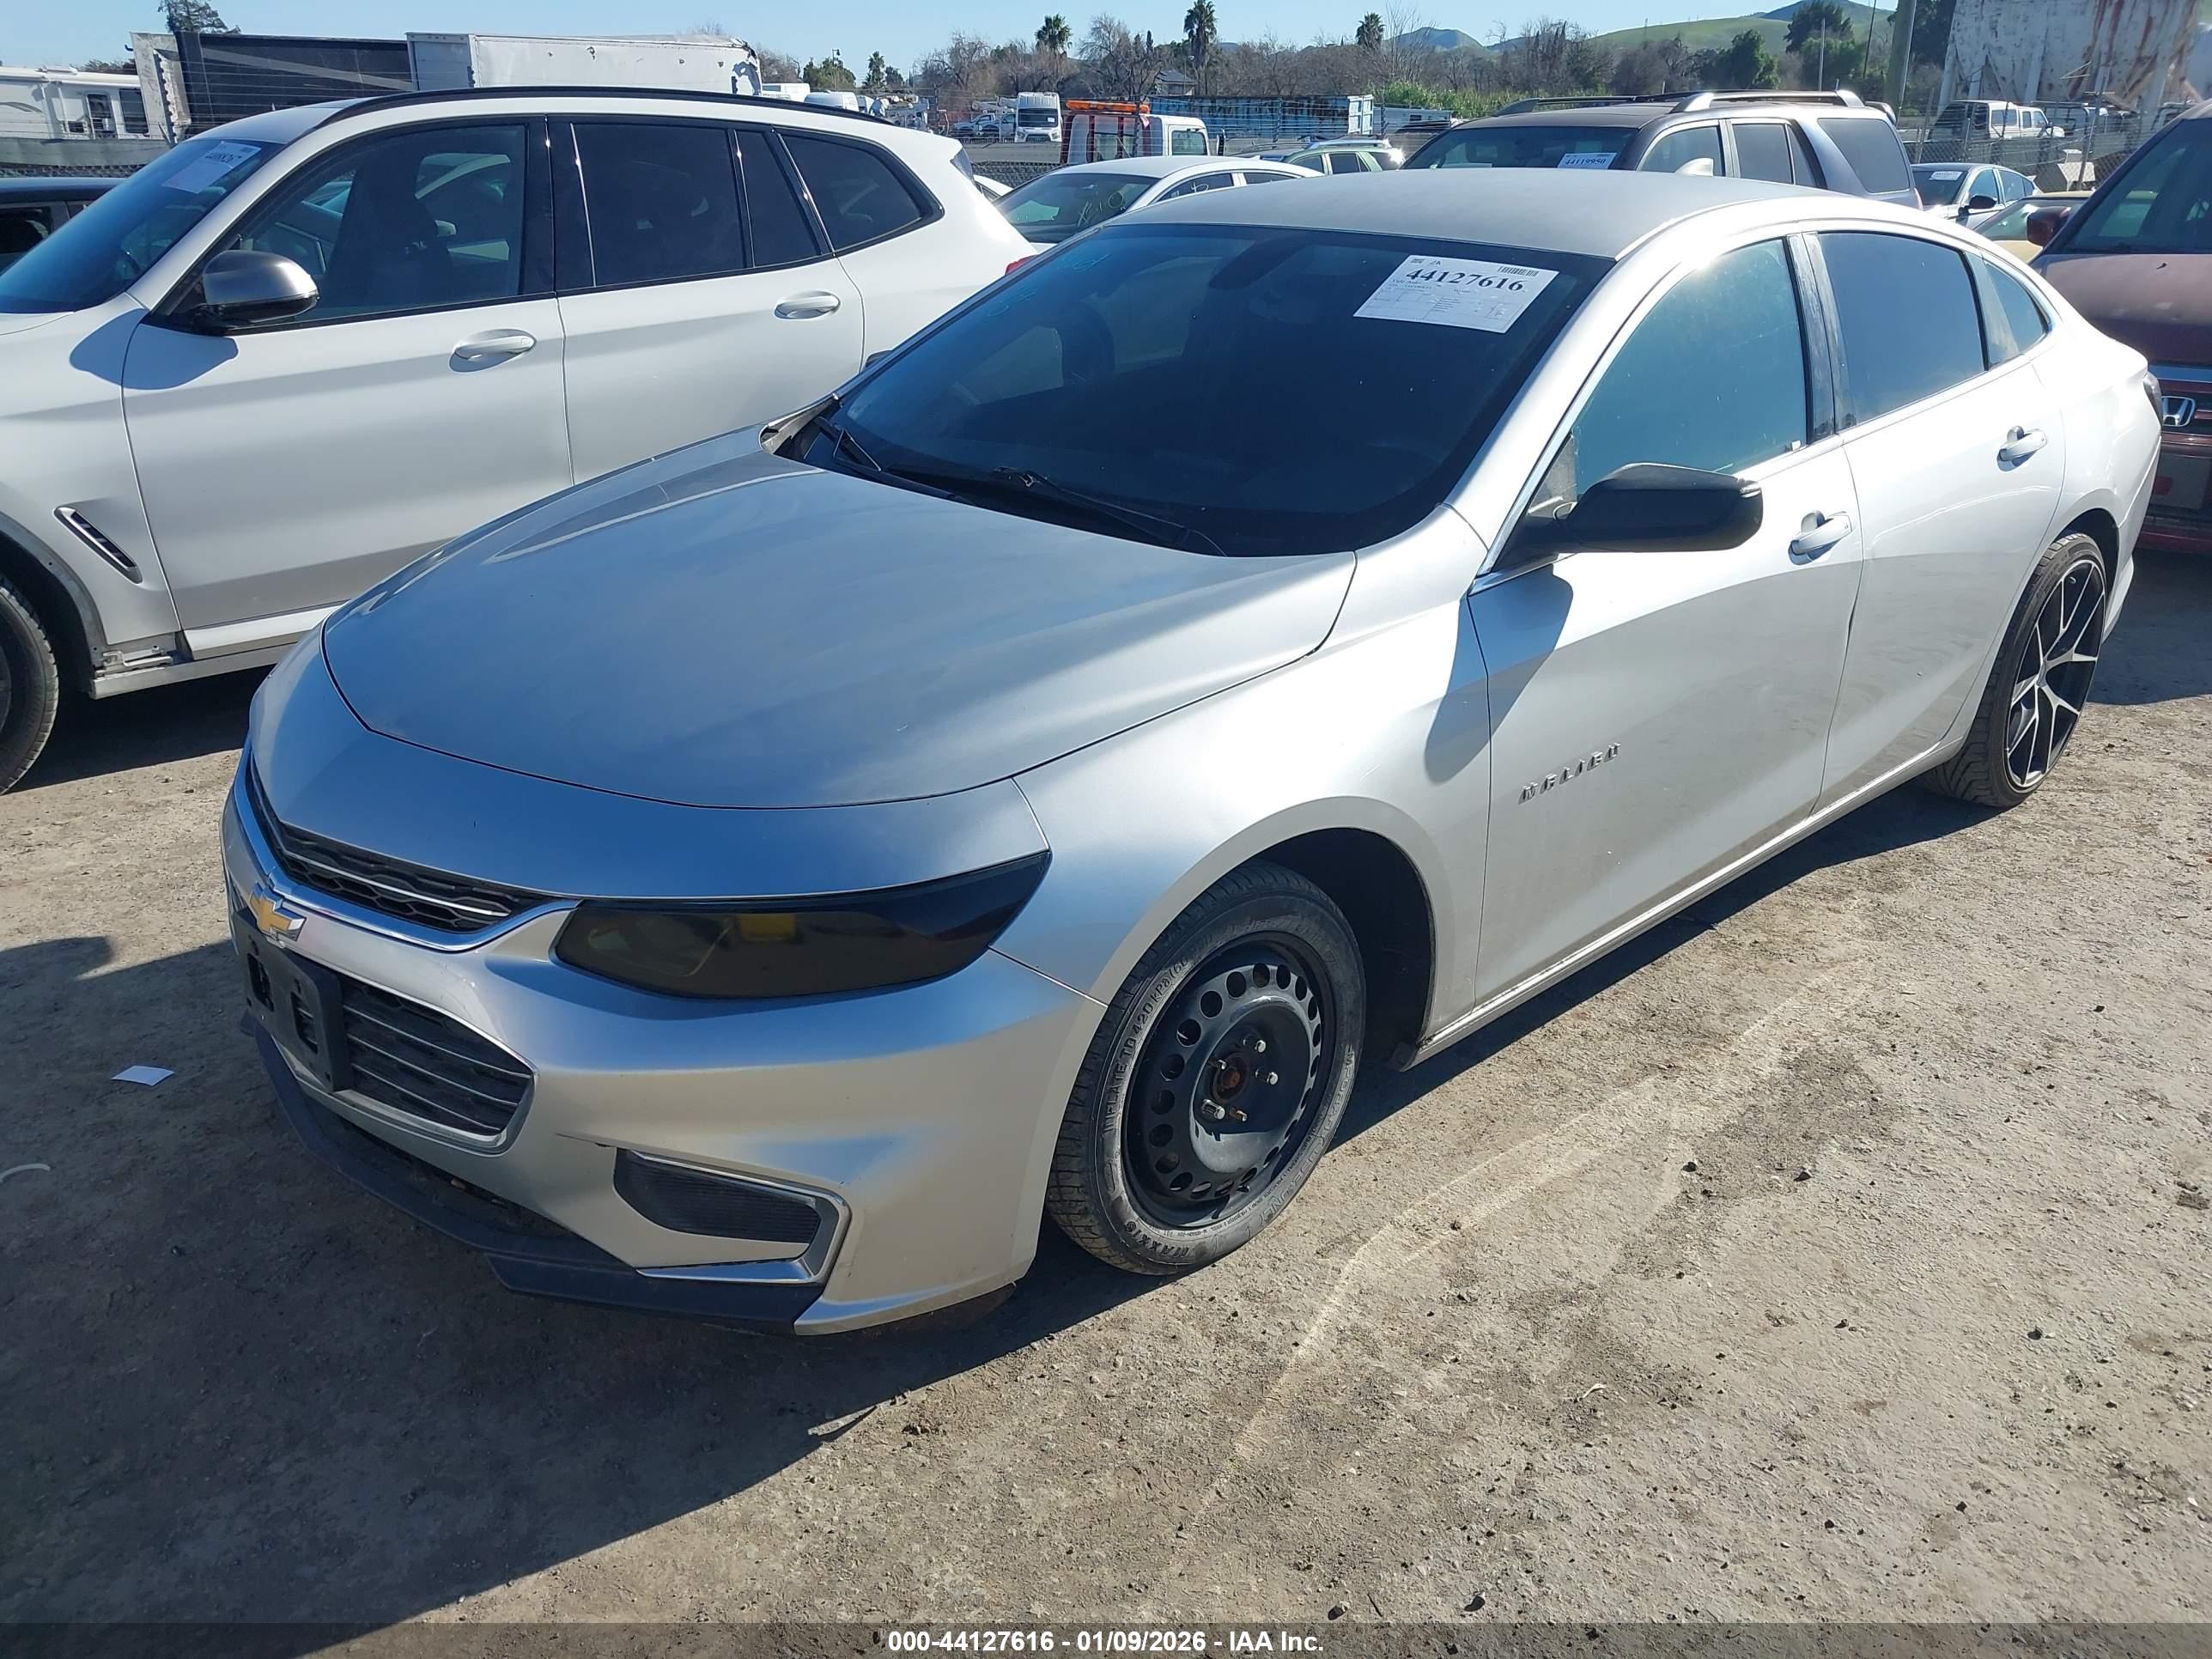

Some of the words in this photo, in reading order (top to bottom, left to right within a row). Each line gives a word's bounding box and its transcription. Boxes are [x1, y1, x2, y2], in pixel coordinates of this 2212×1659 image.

[1406, 268, 1528, 293] 44127616
[1103, 1063, 1127, 1133] INFLATE
[1120, 1036, 1137, 1059] TO
[1133, 1001, 1153, 1035] 420
[1151, 977, 1170, 1003] kPa
[1126, 1221, 1190, 1258] MAXXIS
